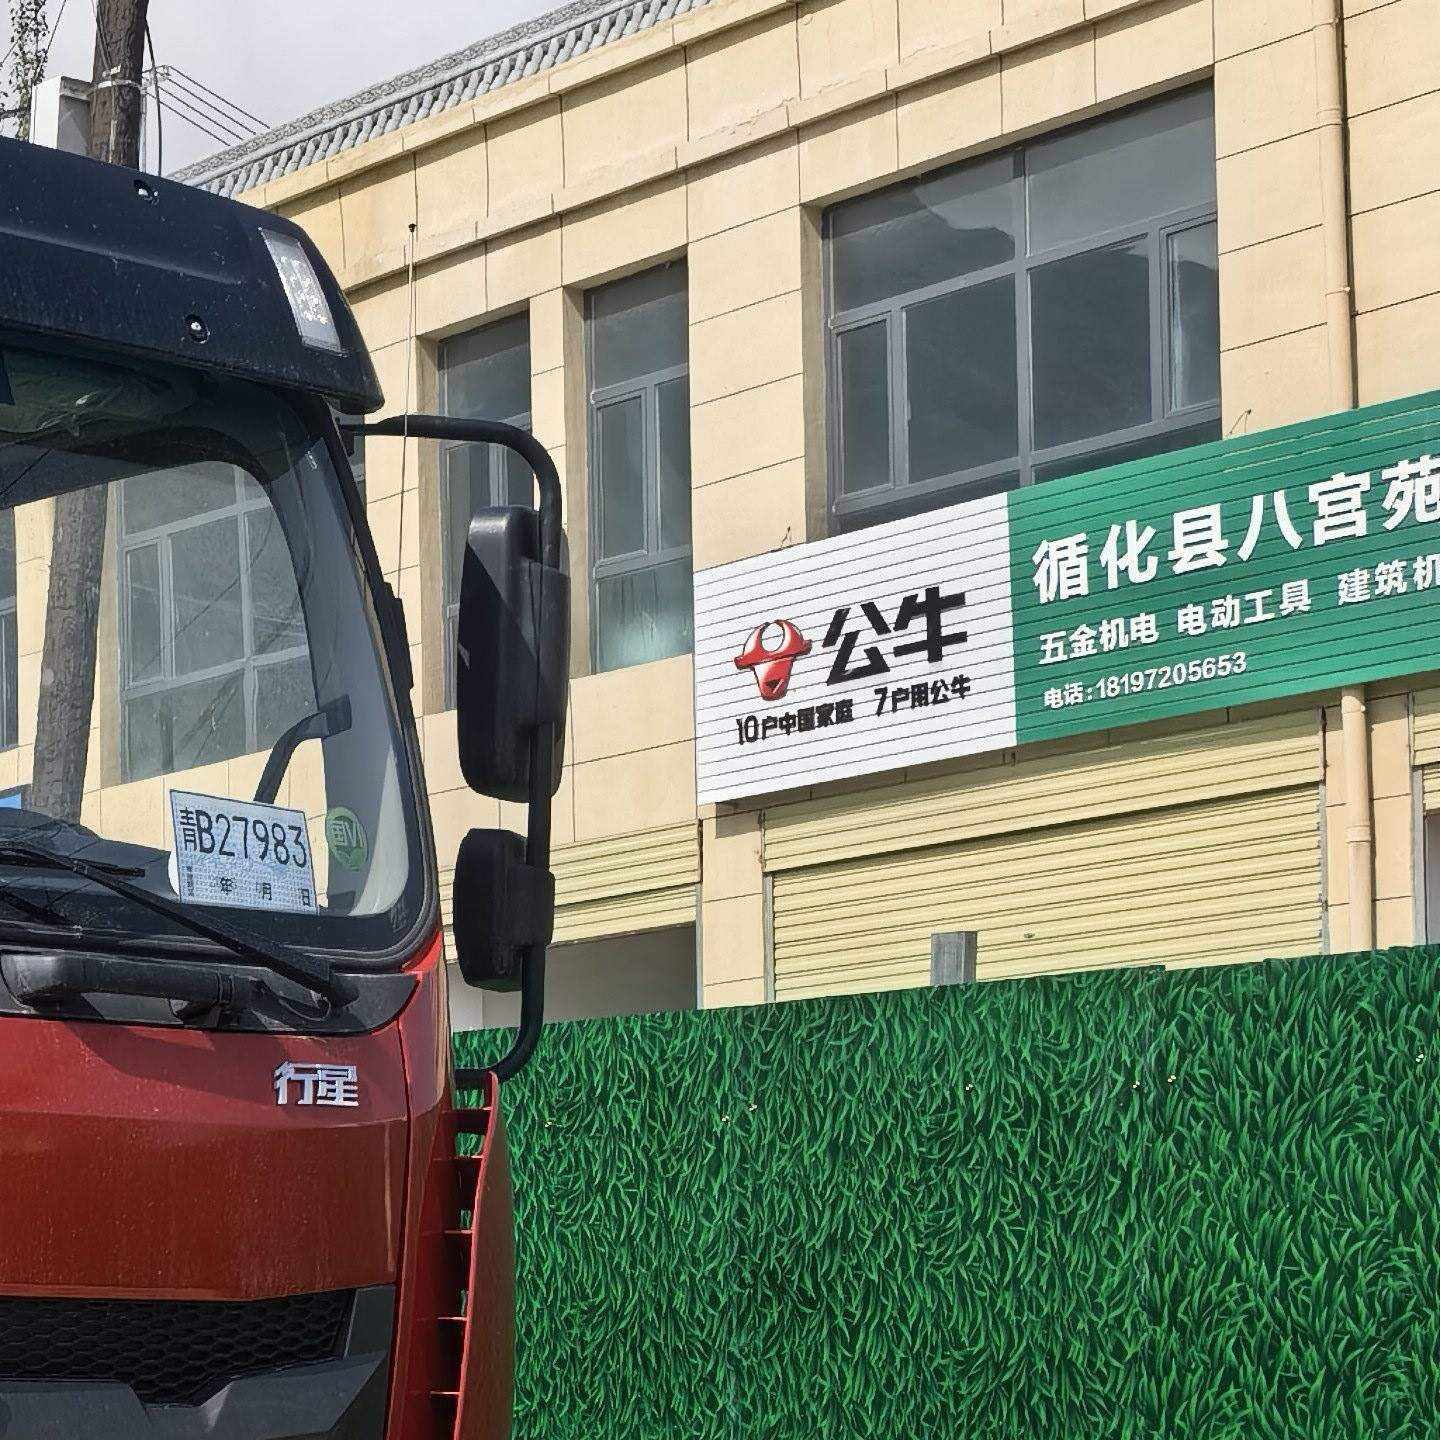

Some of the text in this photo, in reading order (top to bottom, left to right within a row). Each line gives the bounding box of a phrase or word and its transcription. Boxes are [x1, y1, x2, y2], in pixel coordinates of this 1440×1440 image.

[822, 586, 968, 686] 公牛
[1038, 612, 1160, 665] 五金机电
[1177, 578, 1312, 636] 电动工具
[736, 674, 971, 746] 10户中国家庭 7户用公牛
[274, 1061, 359, 1106] 行星
